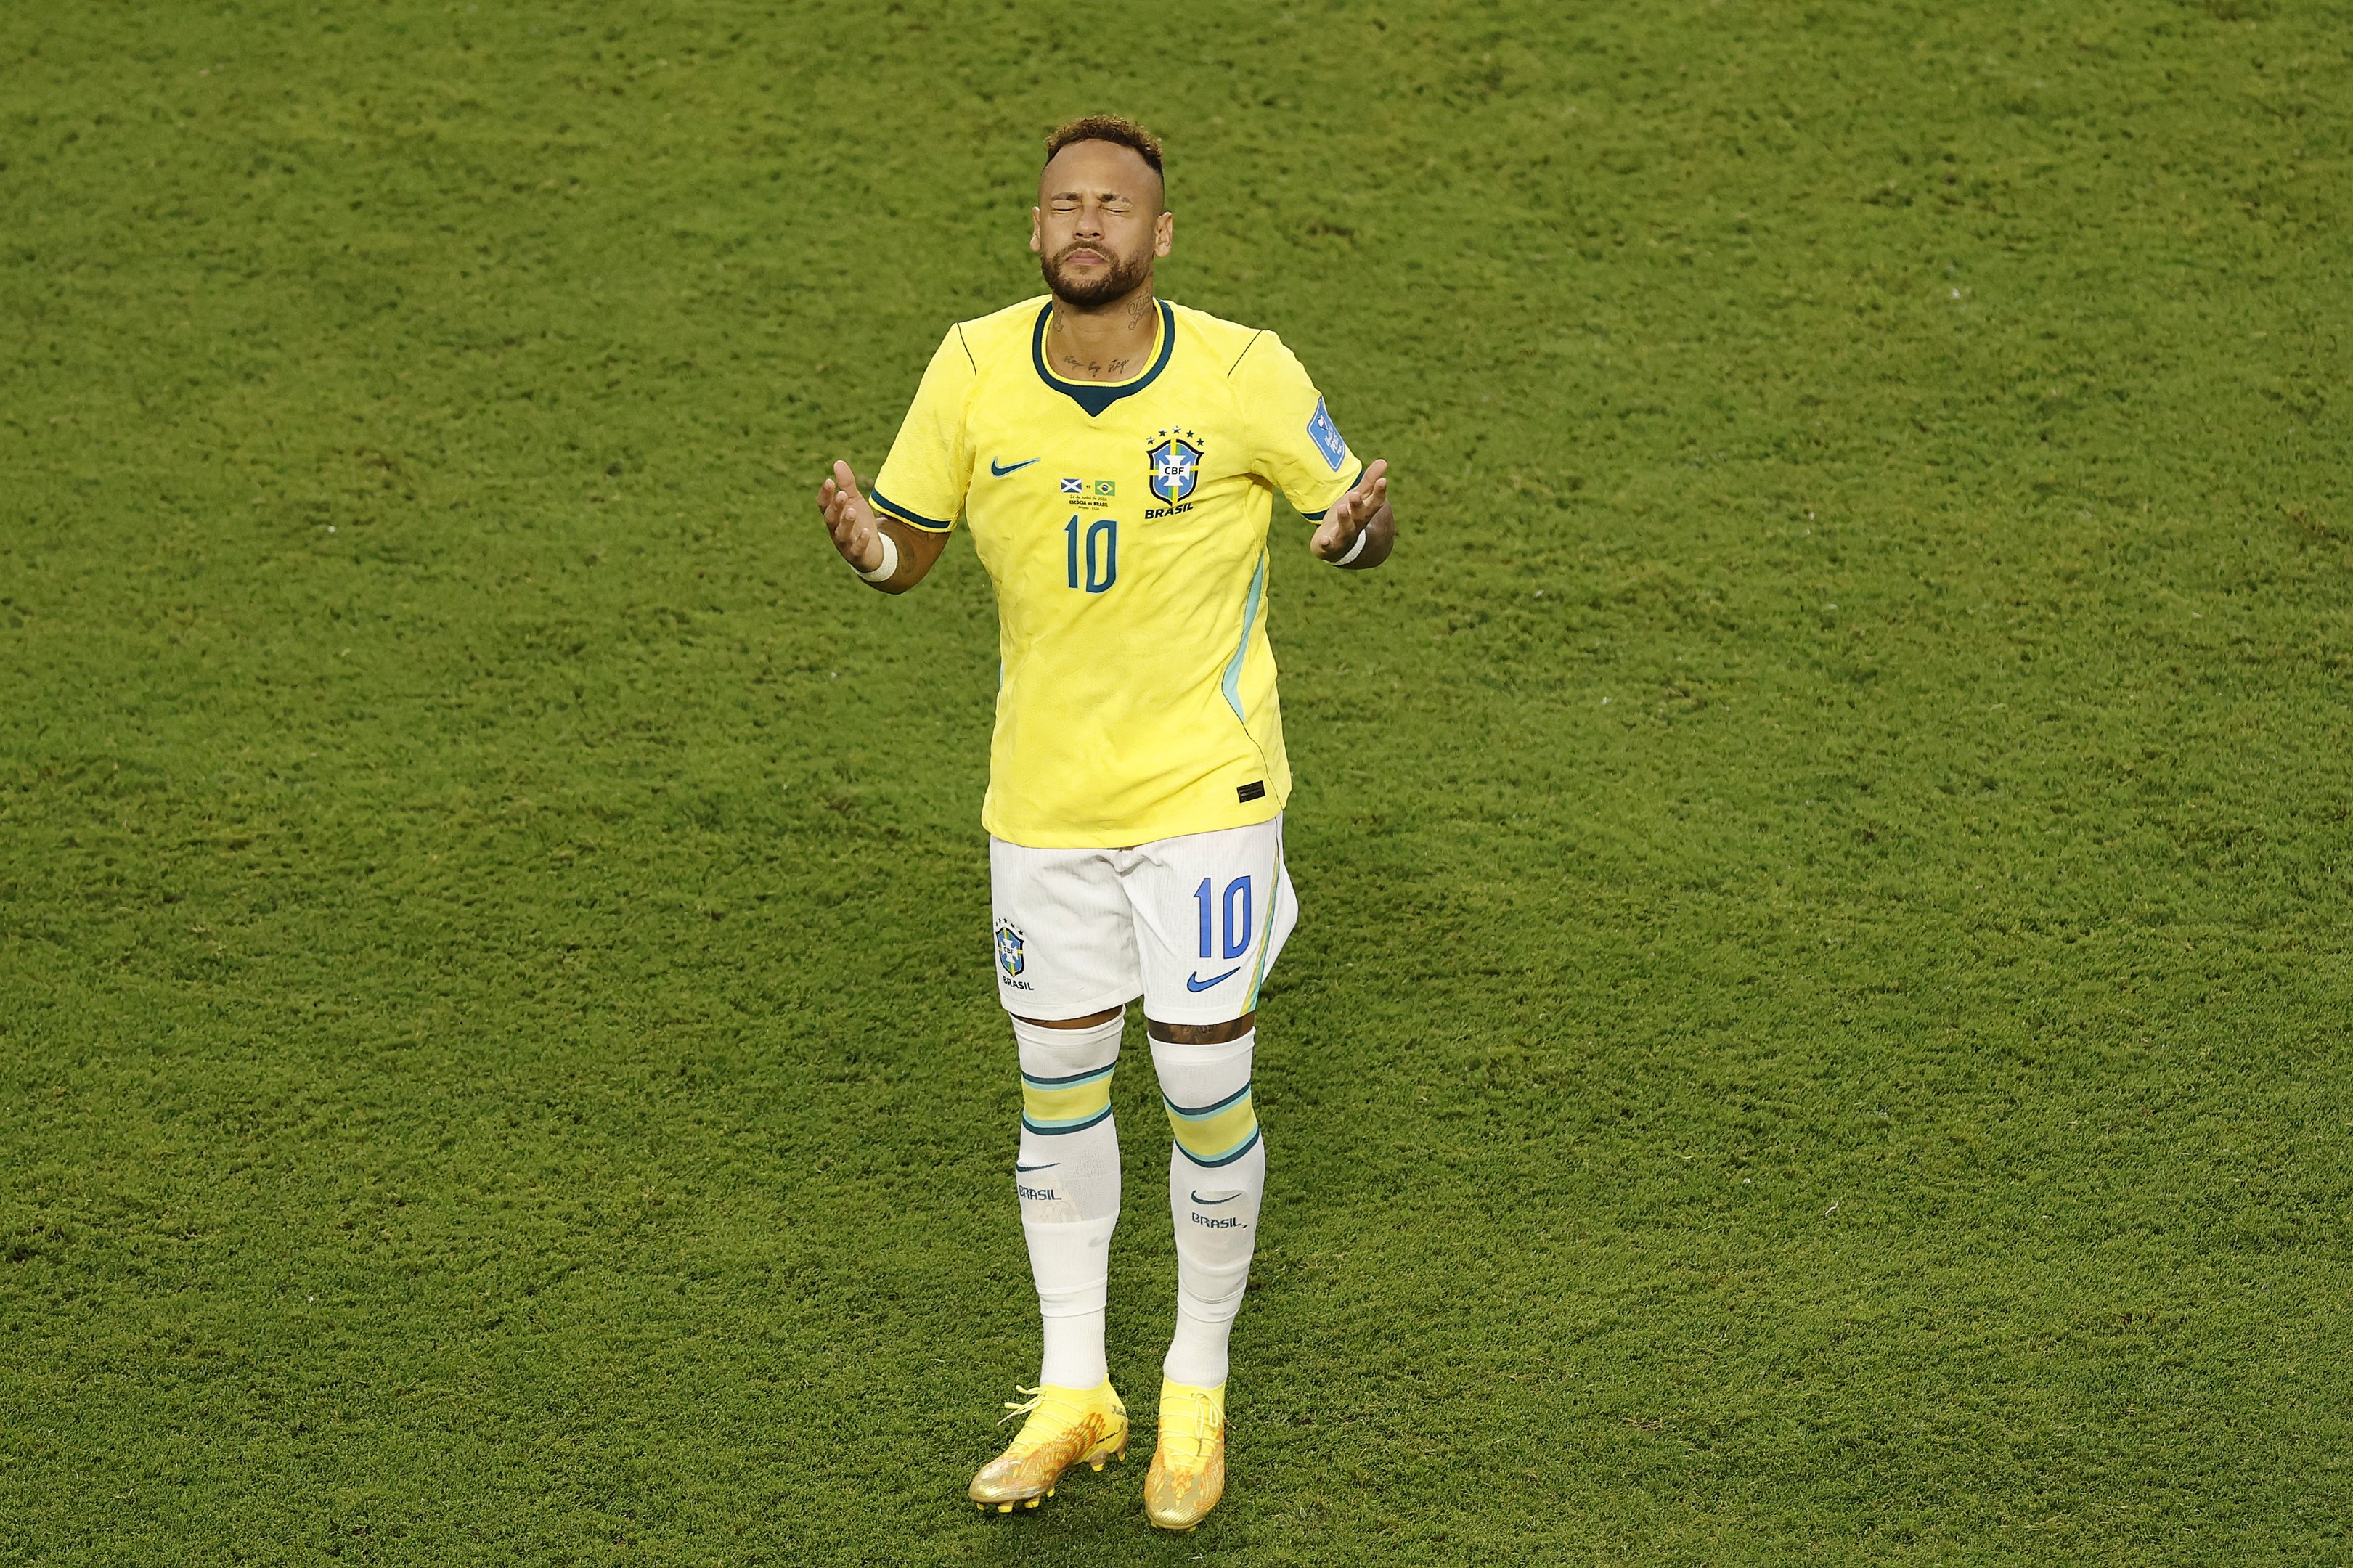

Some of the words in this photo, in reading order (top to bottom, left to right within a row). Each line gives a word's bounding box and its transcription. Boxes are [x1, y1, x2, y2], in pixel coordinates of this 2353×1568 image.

[1145, 502, 1194, 519] BRASIL
[1064, 514, 1118, 594] 10
[1194, 875, 1252, 959] 10
[1003, 976, 1034, 990] BRASIL
[1018, 1185, 1062, 1201] BRASIL
[1191, 1212, 1241, 1229] BRASIL
